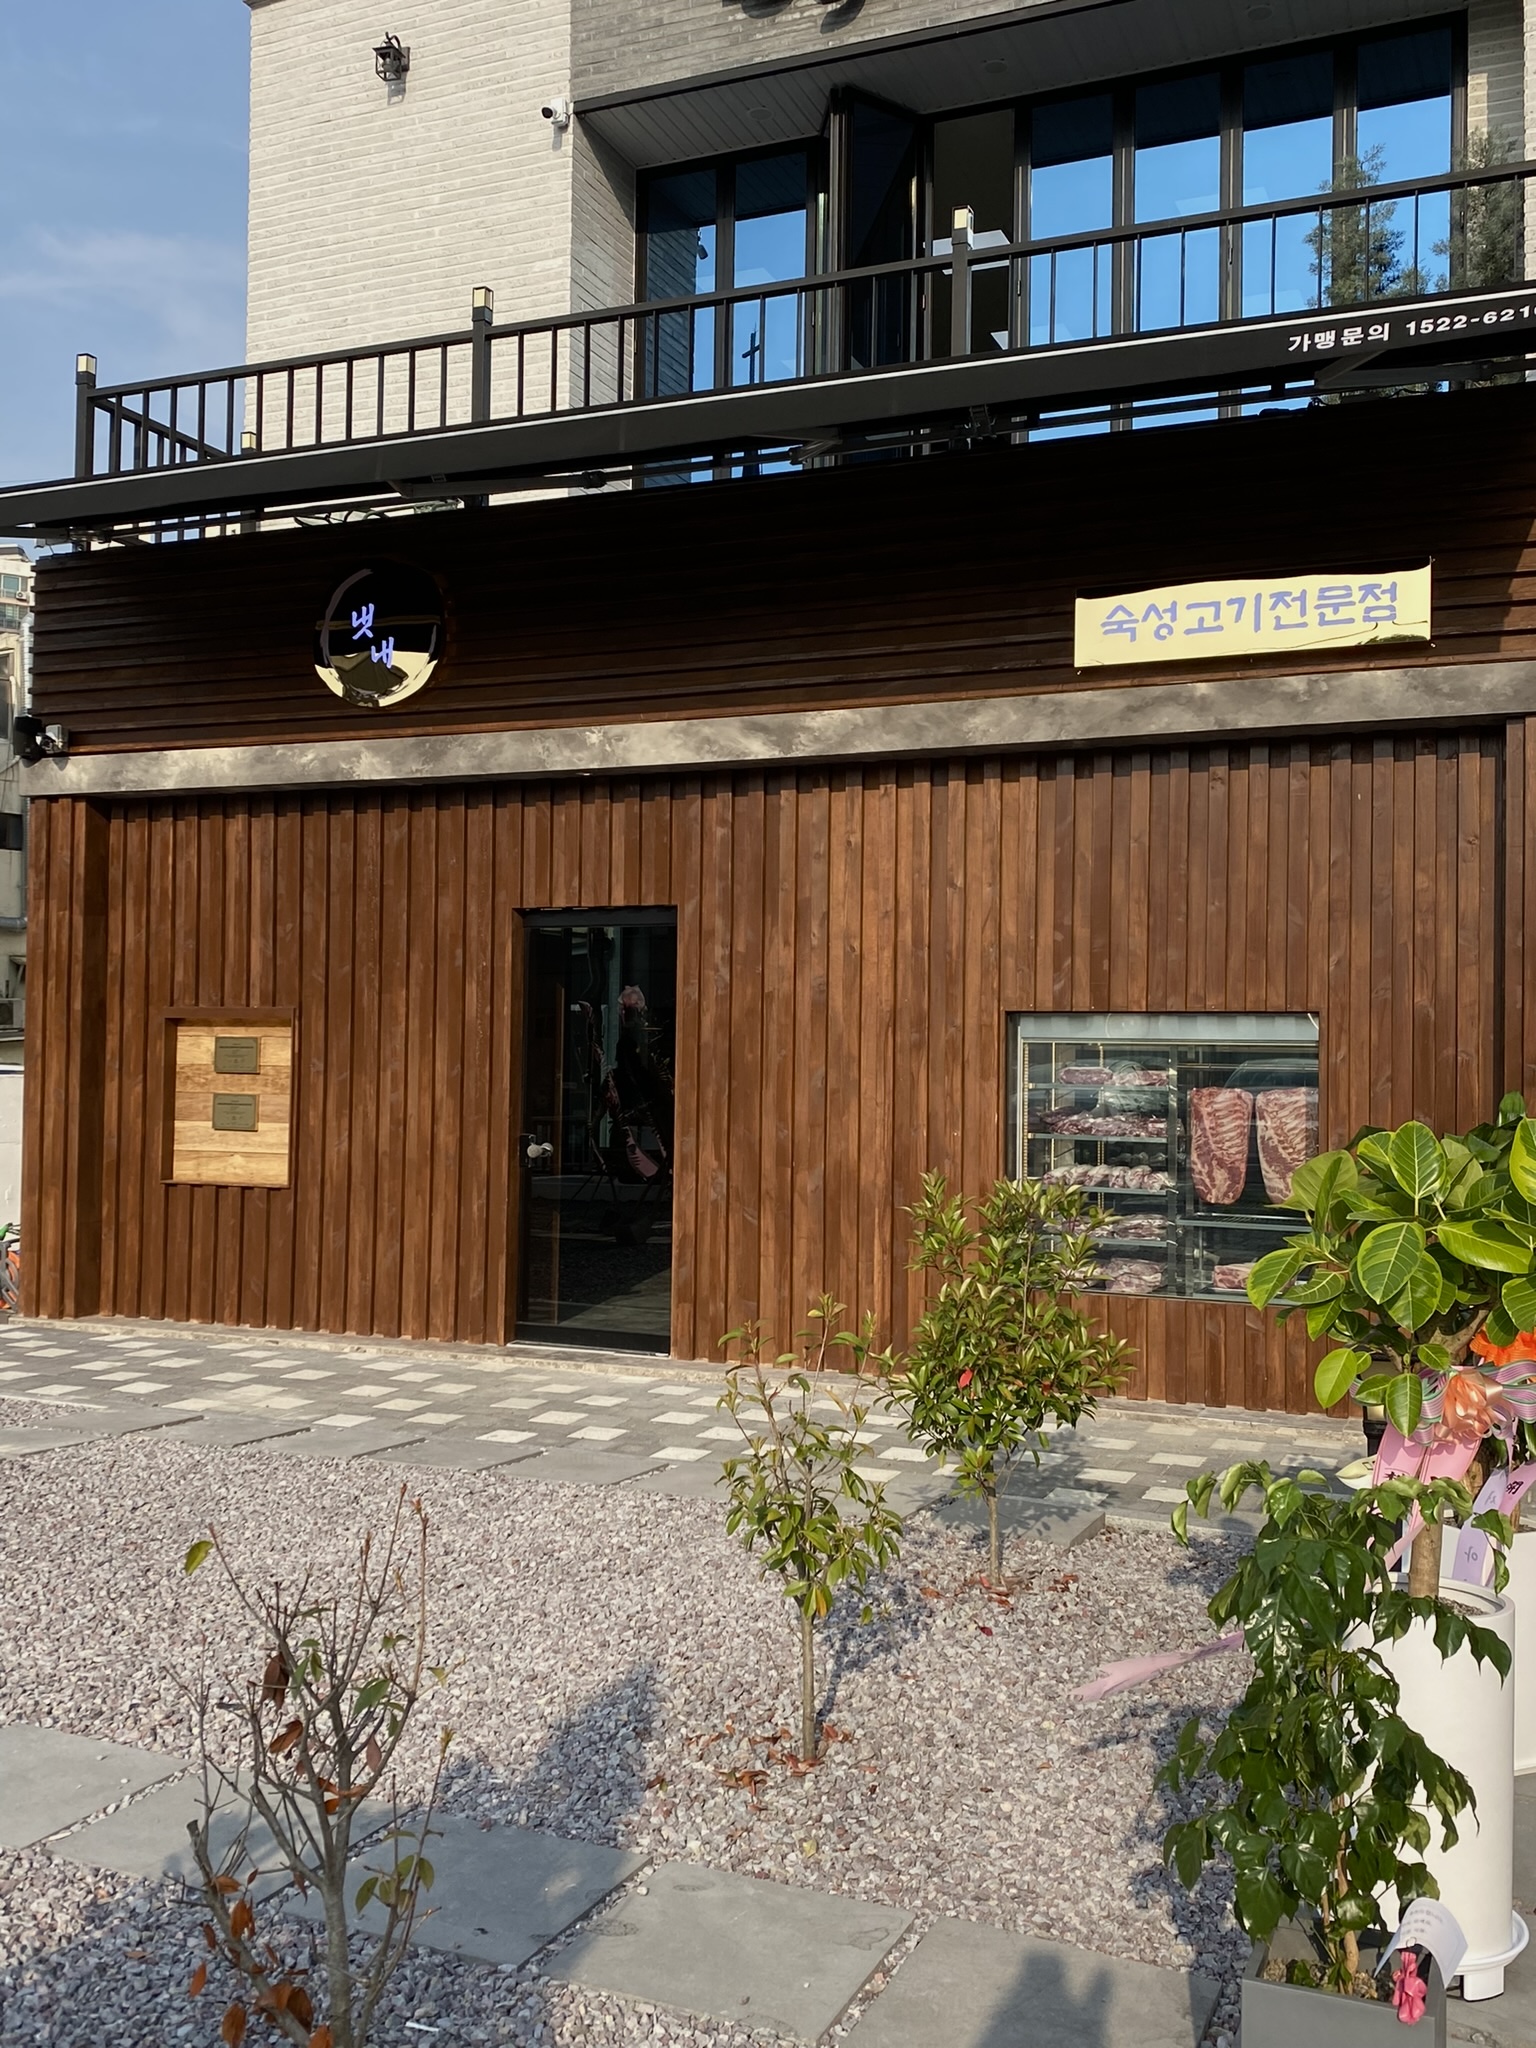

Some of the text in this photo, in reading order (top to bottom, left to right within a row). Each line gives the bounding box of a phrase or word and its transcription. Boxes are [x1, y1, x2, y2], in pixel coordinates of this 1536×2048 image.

[1288, 304, 1536, 352] 가맹문의 1522-621
[1100, 581, 1399, 643] 숙성고기전문점
